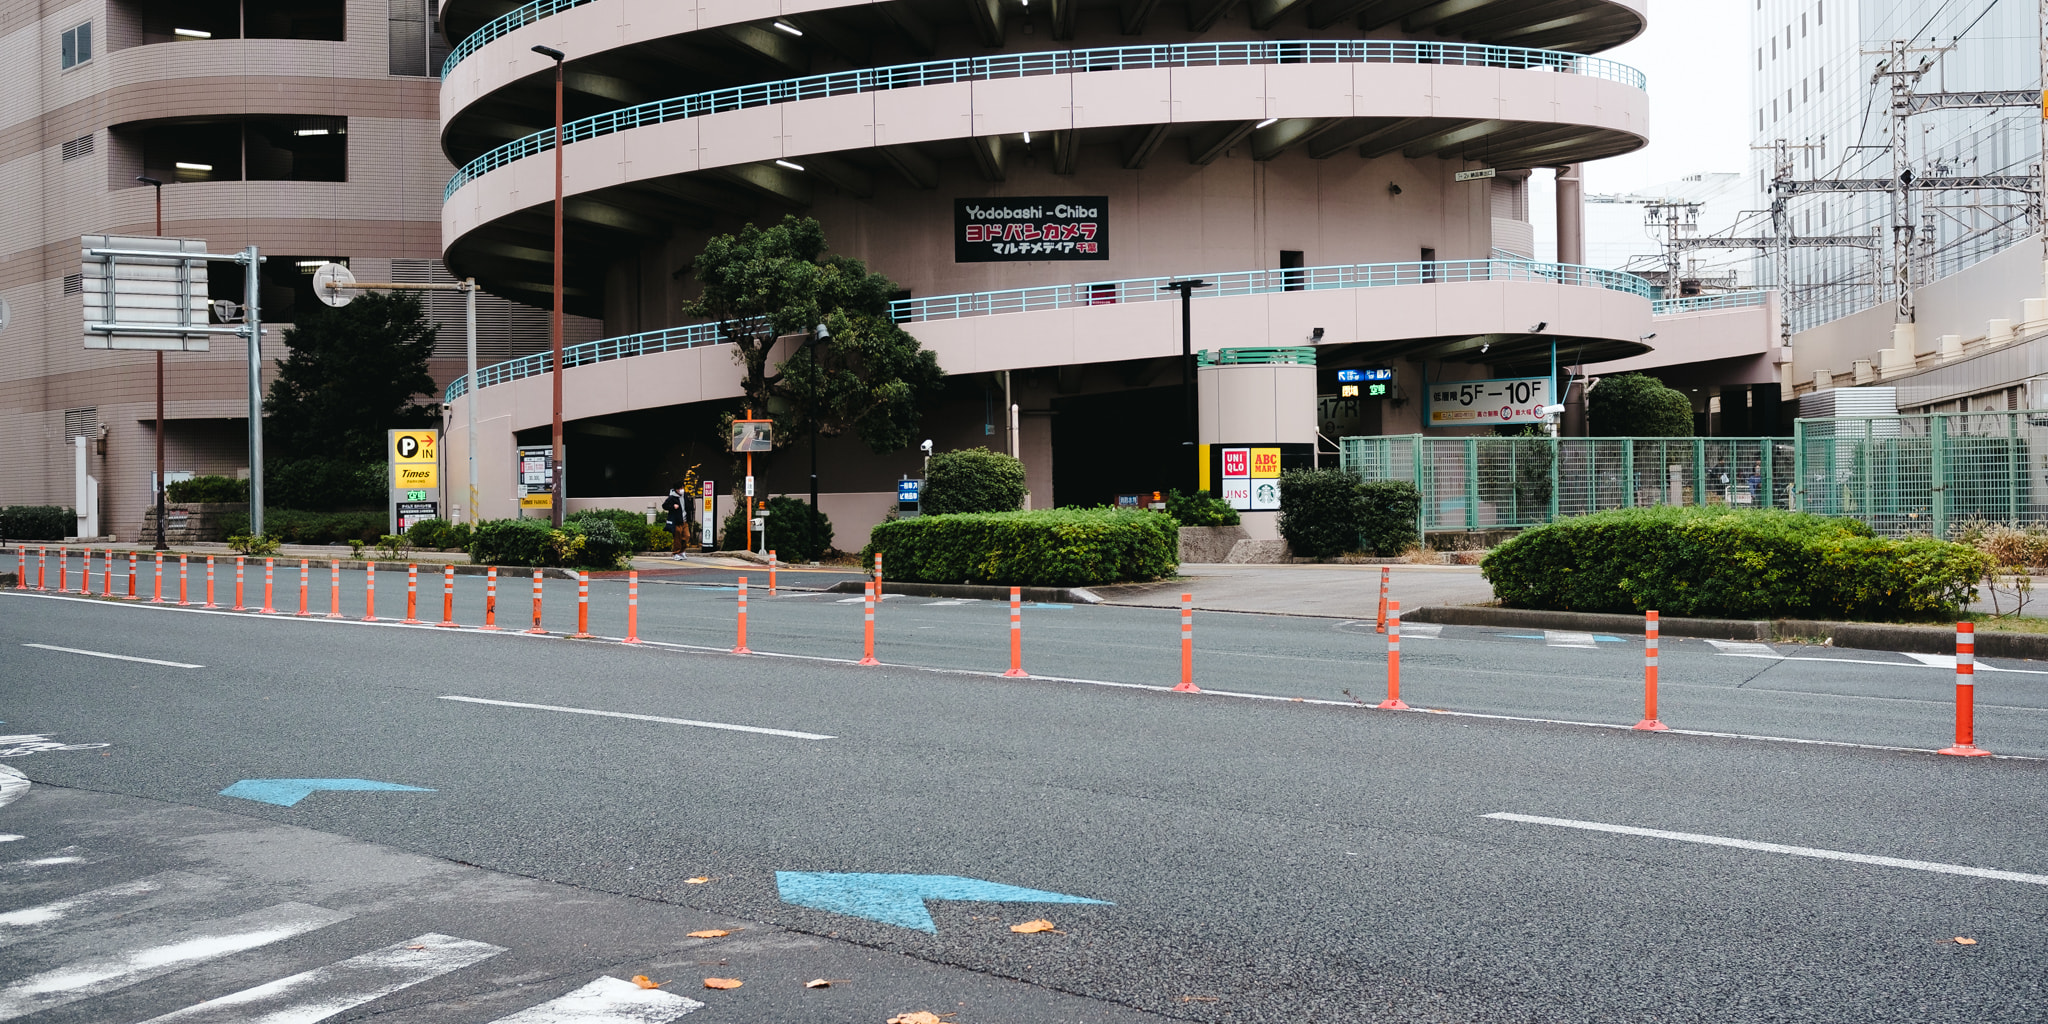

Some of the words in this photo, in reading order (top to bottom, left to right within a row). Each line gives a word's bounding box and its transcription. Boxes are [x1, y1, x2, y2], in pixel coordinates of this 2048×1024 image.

[965, 205, 1042, 220] Yodobashi
[966, 223, 1098, 242] ヨドバシカメラ
[991, 242, 1075, 254] マルチメディア
[1075, 242, 1098, 253] 千葉
[1369, 383, 1386, 396] 空車
[1459, 384, 1484, 406] 5F
[1505, 381, 1541, 404] 10F
[402, 438, 416, 456] P
[422, 449, 433, 458] IN
[1226, 453, 1243, 462] UNI
[1255, 454, 1277, 465] ABC
[402, 469, 430, 478] Times
[1226, 463, 1244, 473] QLO
[407, 490, 426, 501] 空車
